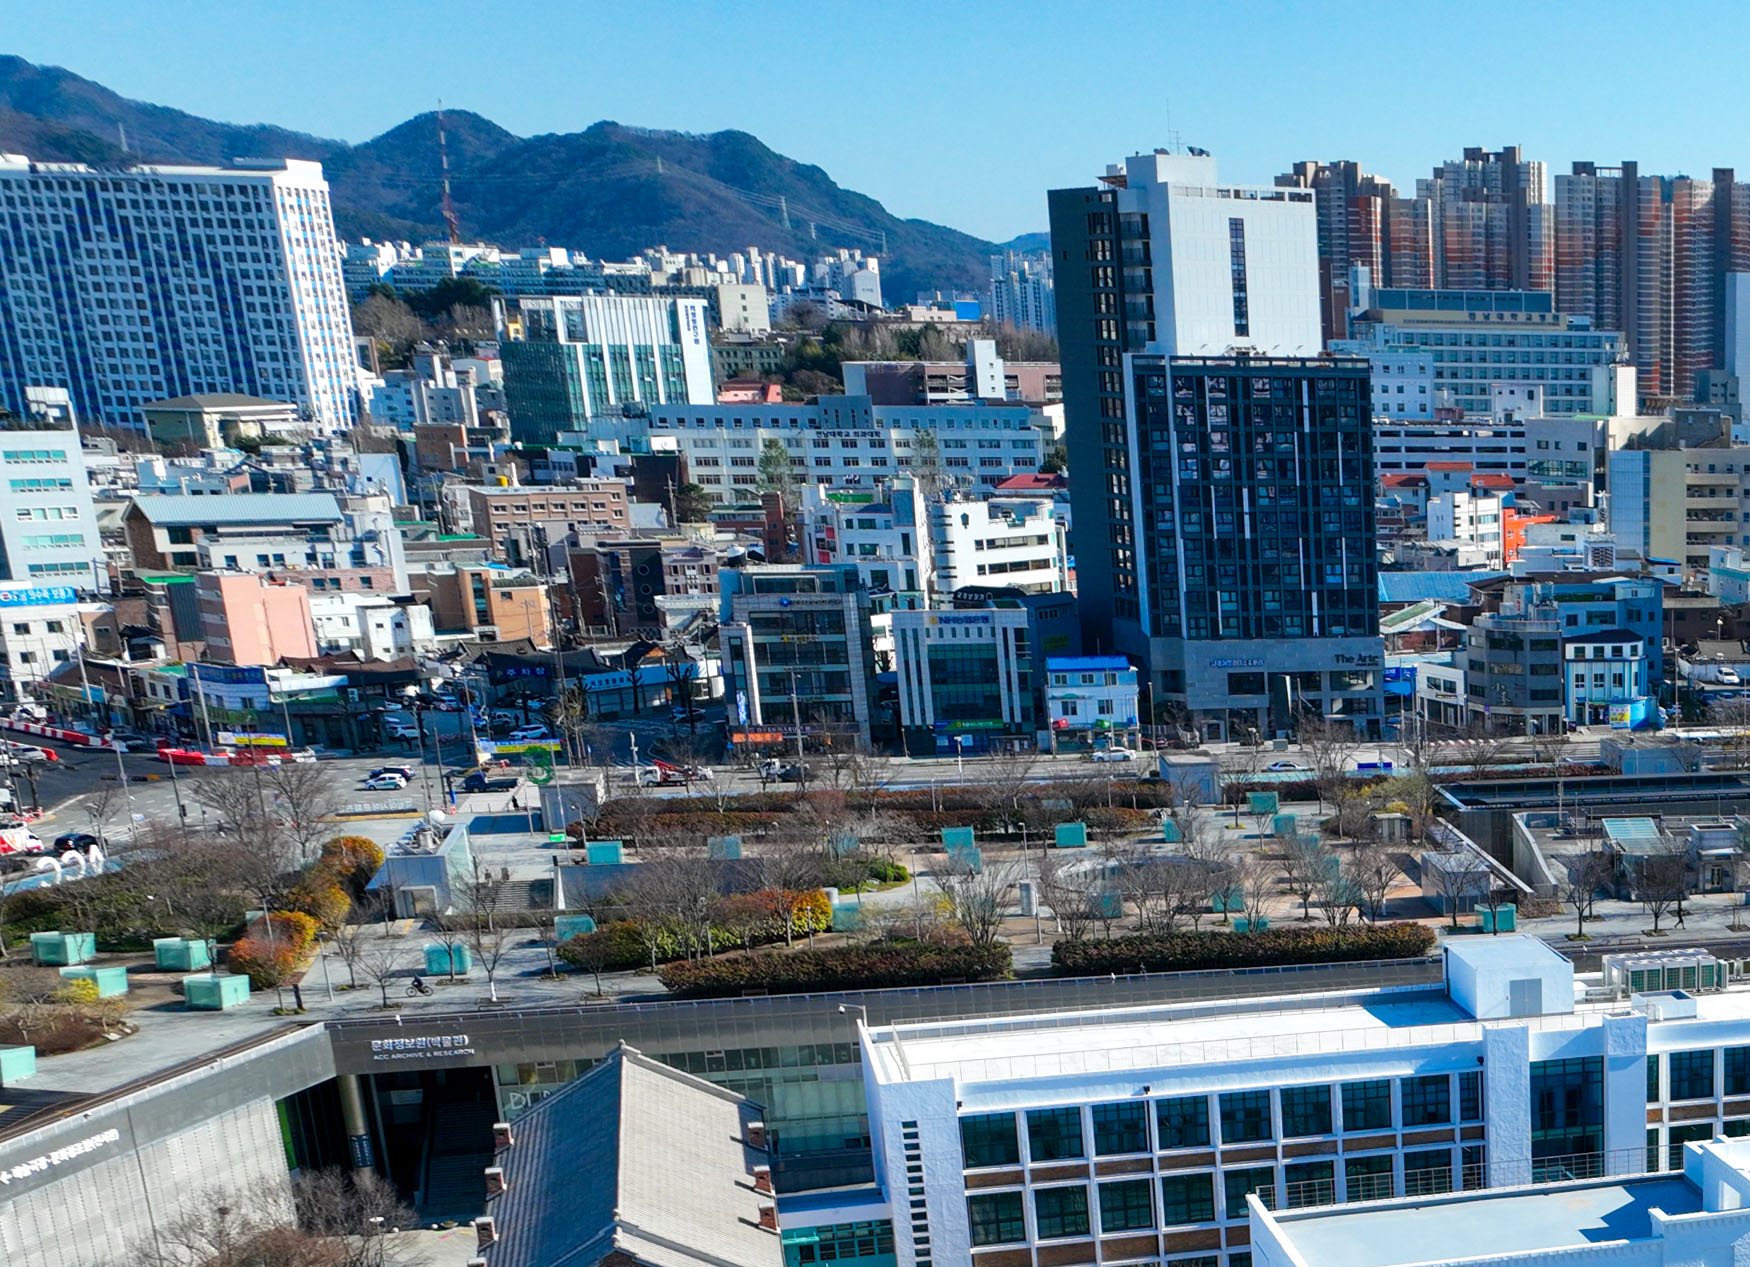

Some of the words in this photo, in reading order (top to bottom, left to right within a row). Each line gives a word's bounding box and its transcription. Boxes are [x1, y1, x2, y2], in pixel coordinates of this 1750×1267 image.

[1335, 654, 1354, 663] The
[506, 667, 545, 677] 주차장
[371, 1034, 470, 1052] 문화정보원(박물관)
[434, 1048, 475, 1057] RESEARCH
